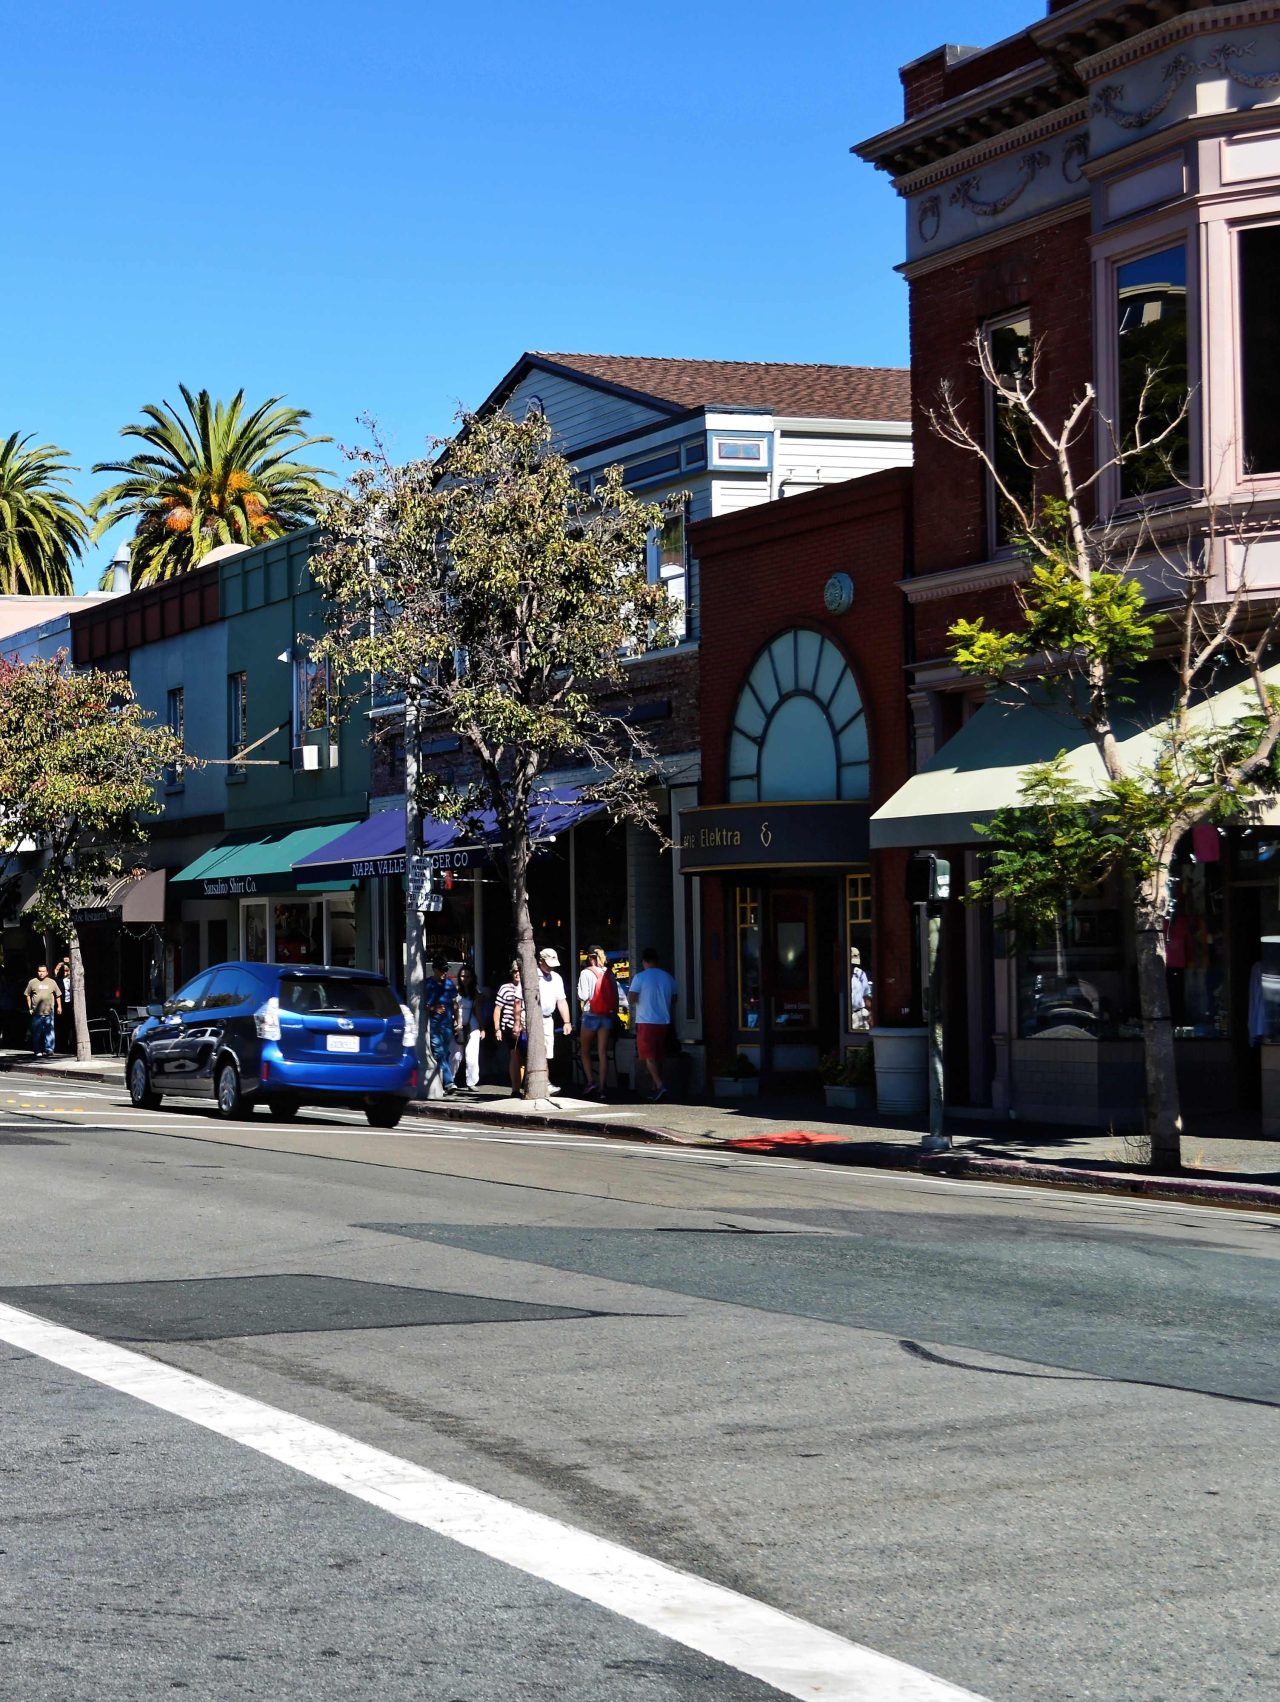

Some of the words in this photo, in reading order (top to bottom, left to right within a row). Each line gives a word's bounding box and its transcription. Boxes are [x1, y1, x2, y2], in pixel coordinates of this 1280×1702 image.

[700, 827, 741, 848] Elektra
[351, 861, 375, 877] NAPA
[376, 859, 407, 875] VALLE
[453, 852, 469, 868] CO
[203, 879, 228, 895] Sausalito
[229, 877, 244, 893] Shirt
